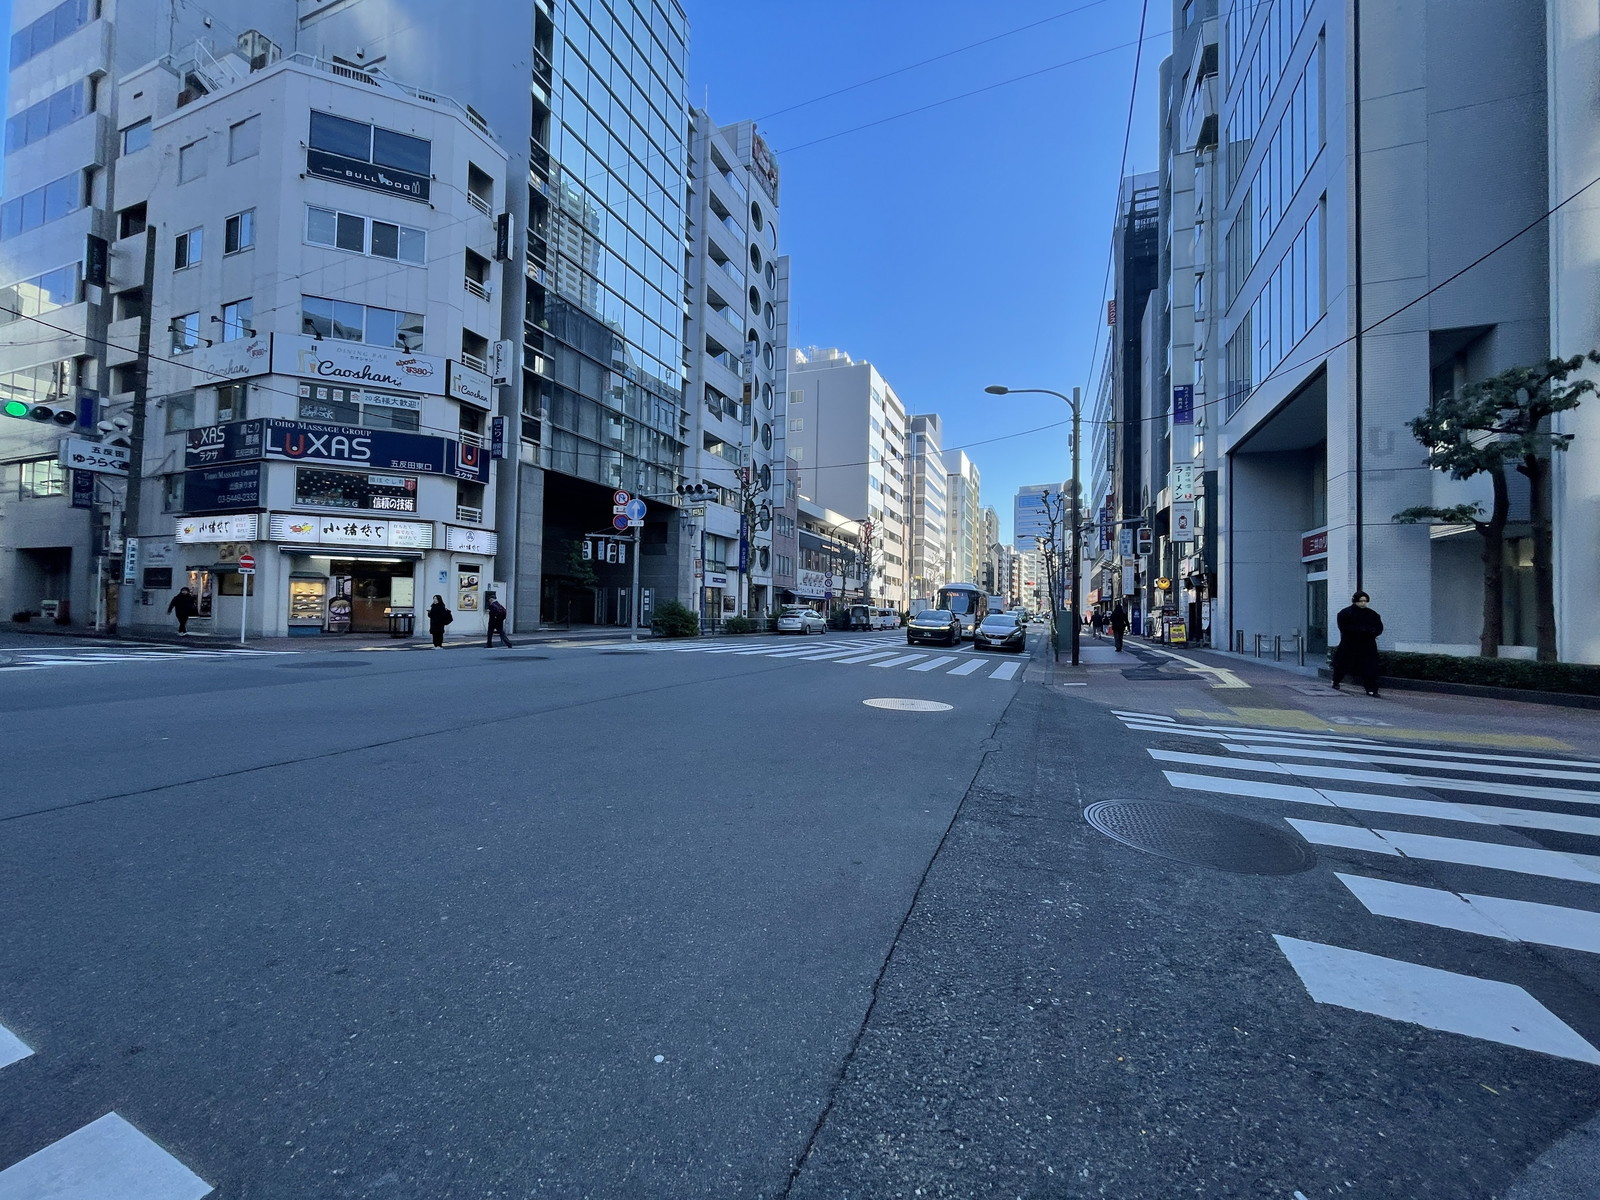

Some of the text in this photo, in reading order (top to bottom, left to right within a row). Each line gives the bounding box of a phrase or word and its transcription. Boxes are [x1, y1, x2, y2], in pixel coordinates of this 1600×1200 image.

[346, 170, 377, 183] BULL
[297, 422, 339, 433] MASSAGE
[342, 426, 372, 437] GROUP
[266, 428, 372, 460] LUXAS
[92, 446, 125, 458] 五反田
[200, 450, 218, 461] ラクサ
[390, 460, 433, 471] 五反田東口
[1174, 465, 1183, 500] ラーメン
[373, 496, 414, 511] 信頼の技術
